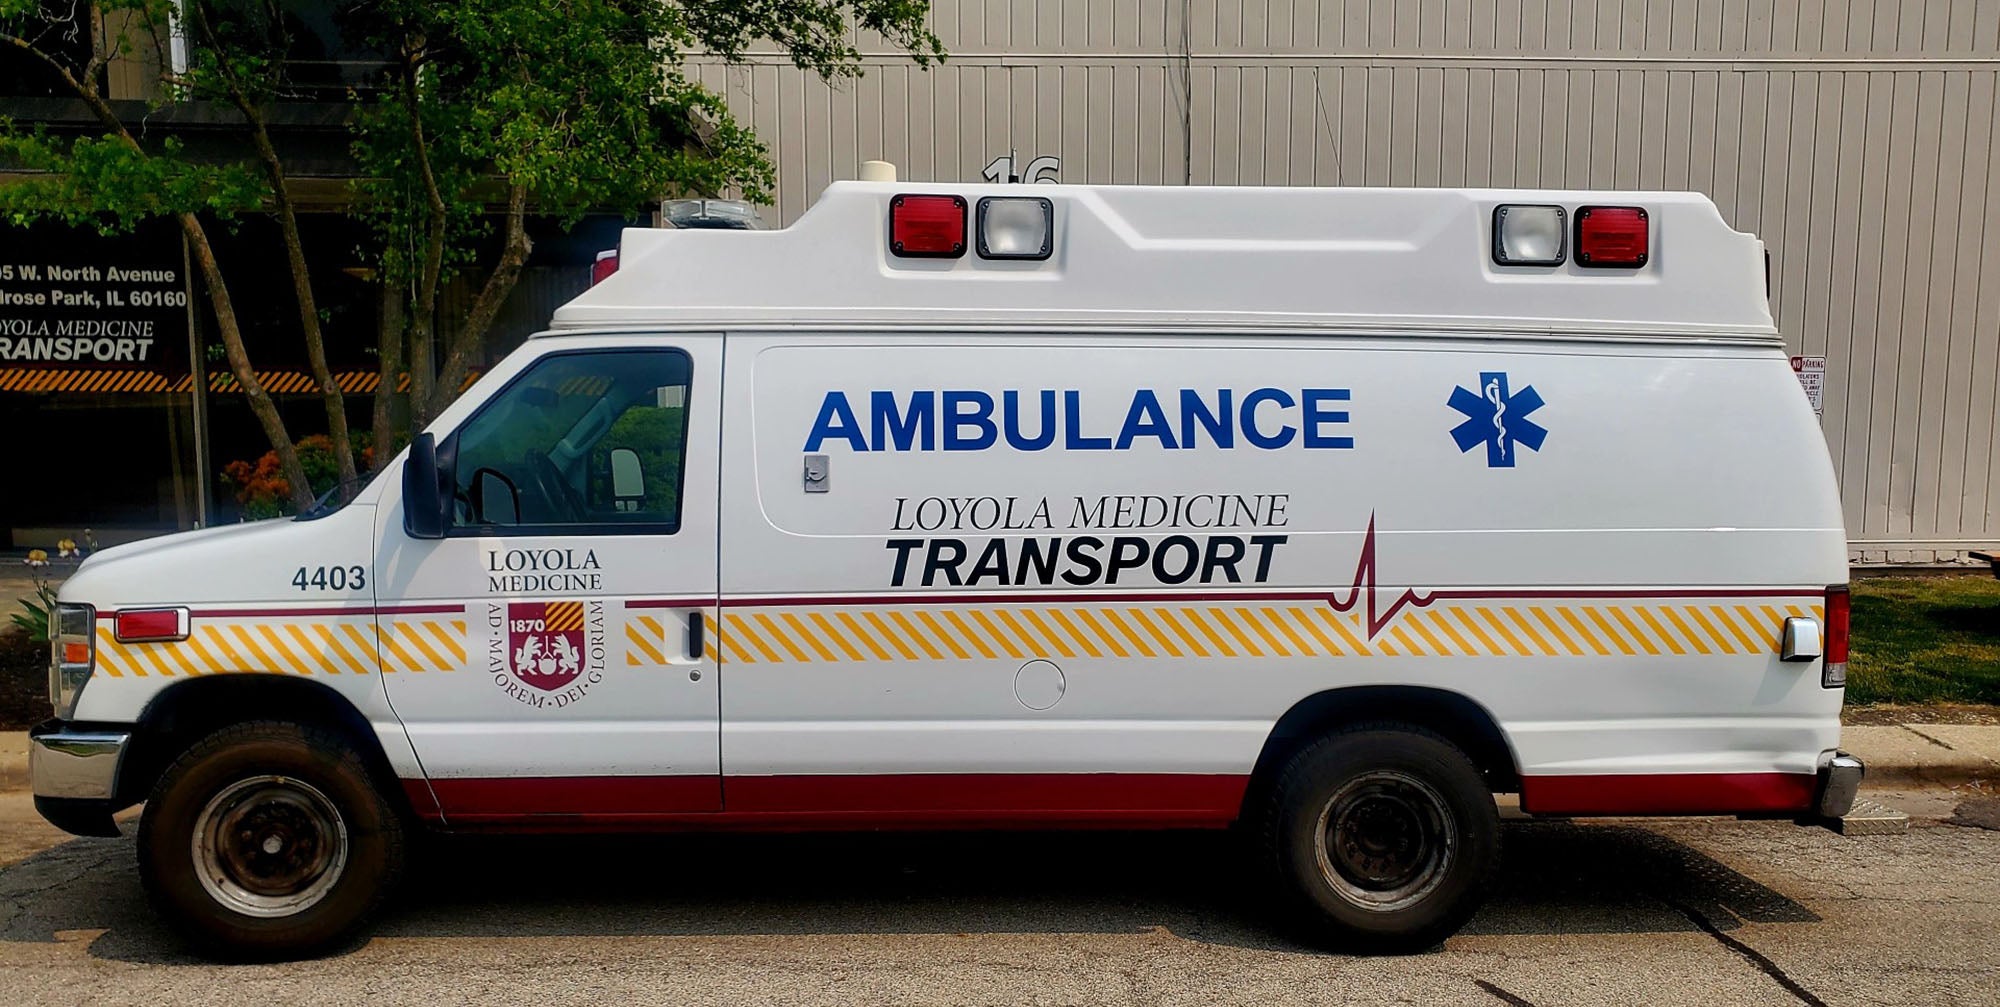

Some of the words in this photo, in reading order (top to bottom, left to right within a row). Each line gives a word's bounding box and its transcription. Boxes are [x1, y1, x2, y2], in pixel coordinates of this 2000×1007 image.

[0, 264, 14, 281] 5
[19, 264, 41, 281] W.
[48, 265, 100, 282] North
[106, 266, 175, 282] Avenue
[51, 289, 100, 309] Park,
[106, 290, 124, 306] IL
[130, 291, 187, 307] 60160
[0, 319, 50, 336] YOLA
[55, 320, 154, 337] MEDICINE
[0, 337, 154, 361] RANSPORT
[803, 388, 1354, 451] AMBULANCE
[890, 497, 1055, 531] LOYOLA
[1066, 494, 1290, 529] MEDICINE
[488, 549, 602, 572] LOYOLA
[886, 535, 1289, 587] TRANSPORT
[291, 565, 366, 591] 4403
[488, 574, 602, 592] MEDICINE
[488, 603, 502, 628] AD
[510, 619, 545, 633] 1870
[588, 600, 606, 684] GLORIAM
[489, 639, 545, 709] MAJOREM
[554, 685, 587, 708] DEI
